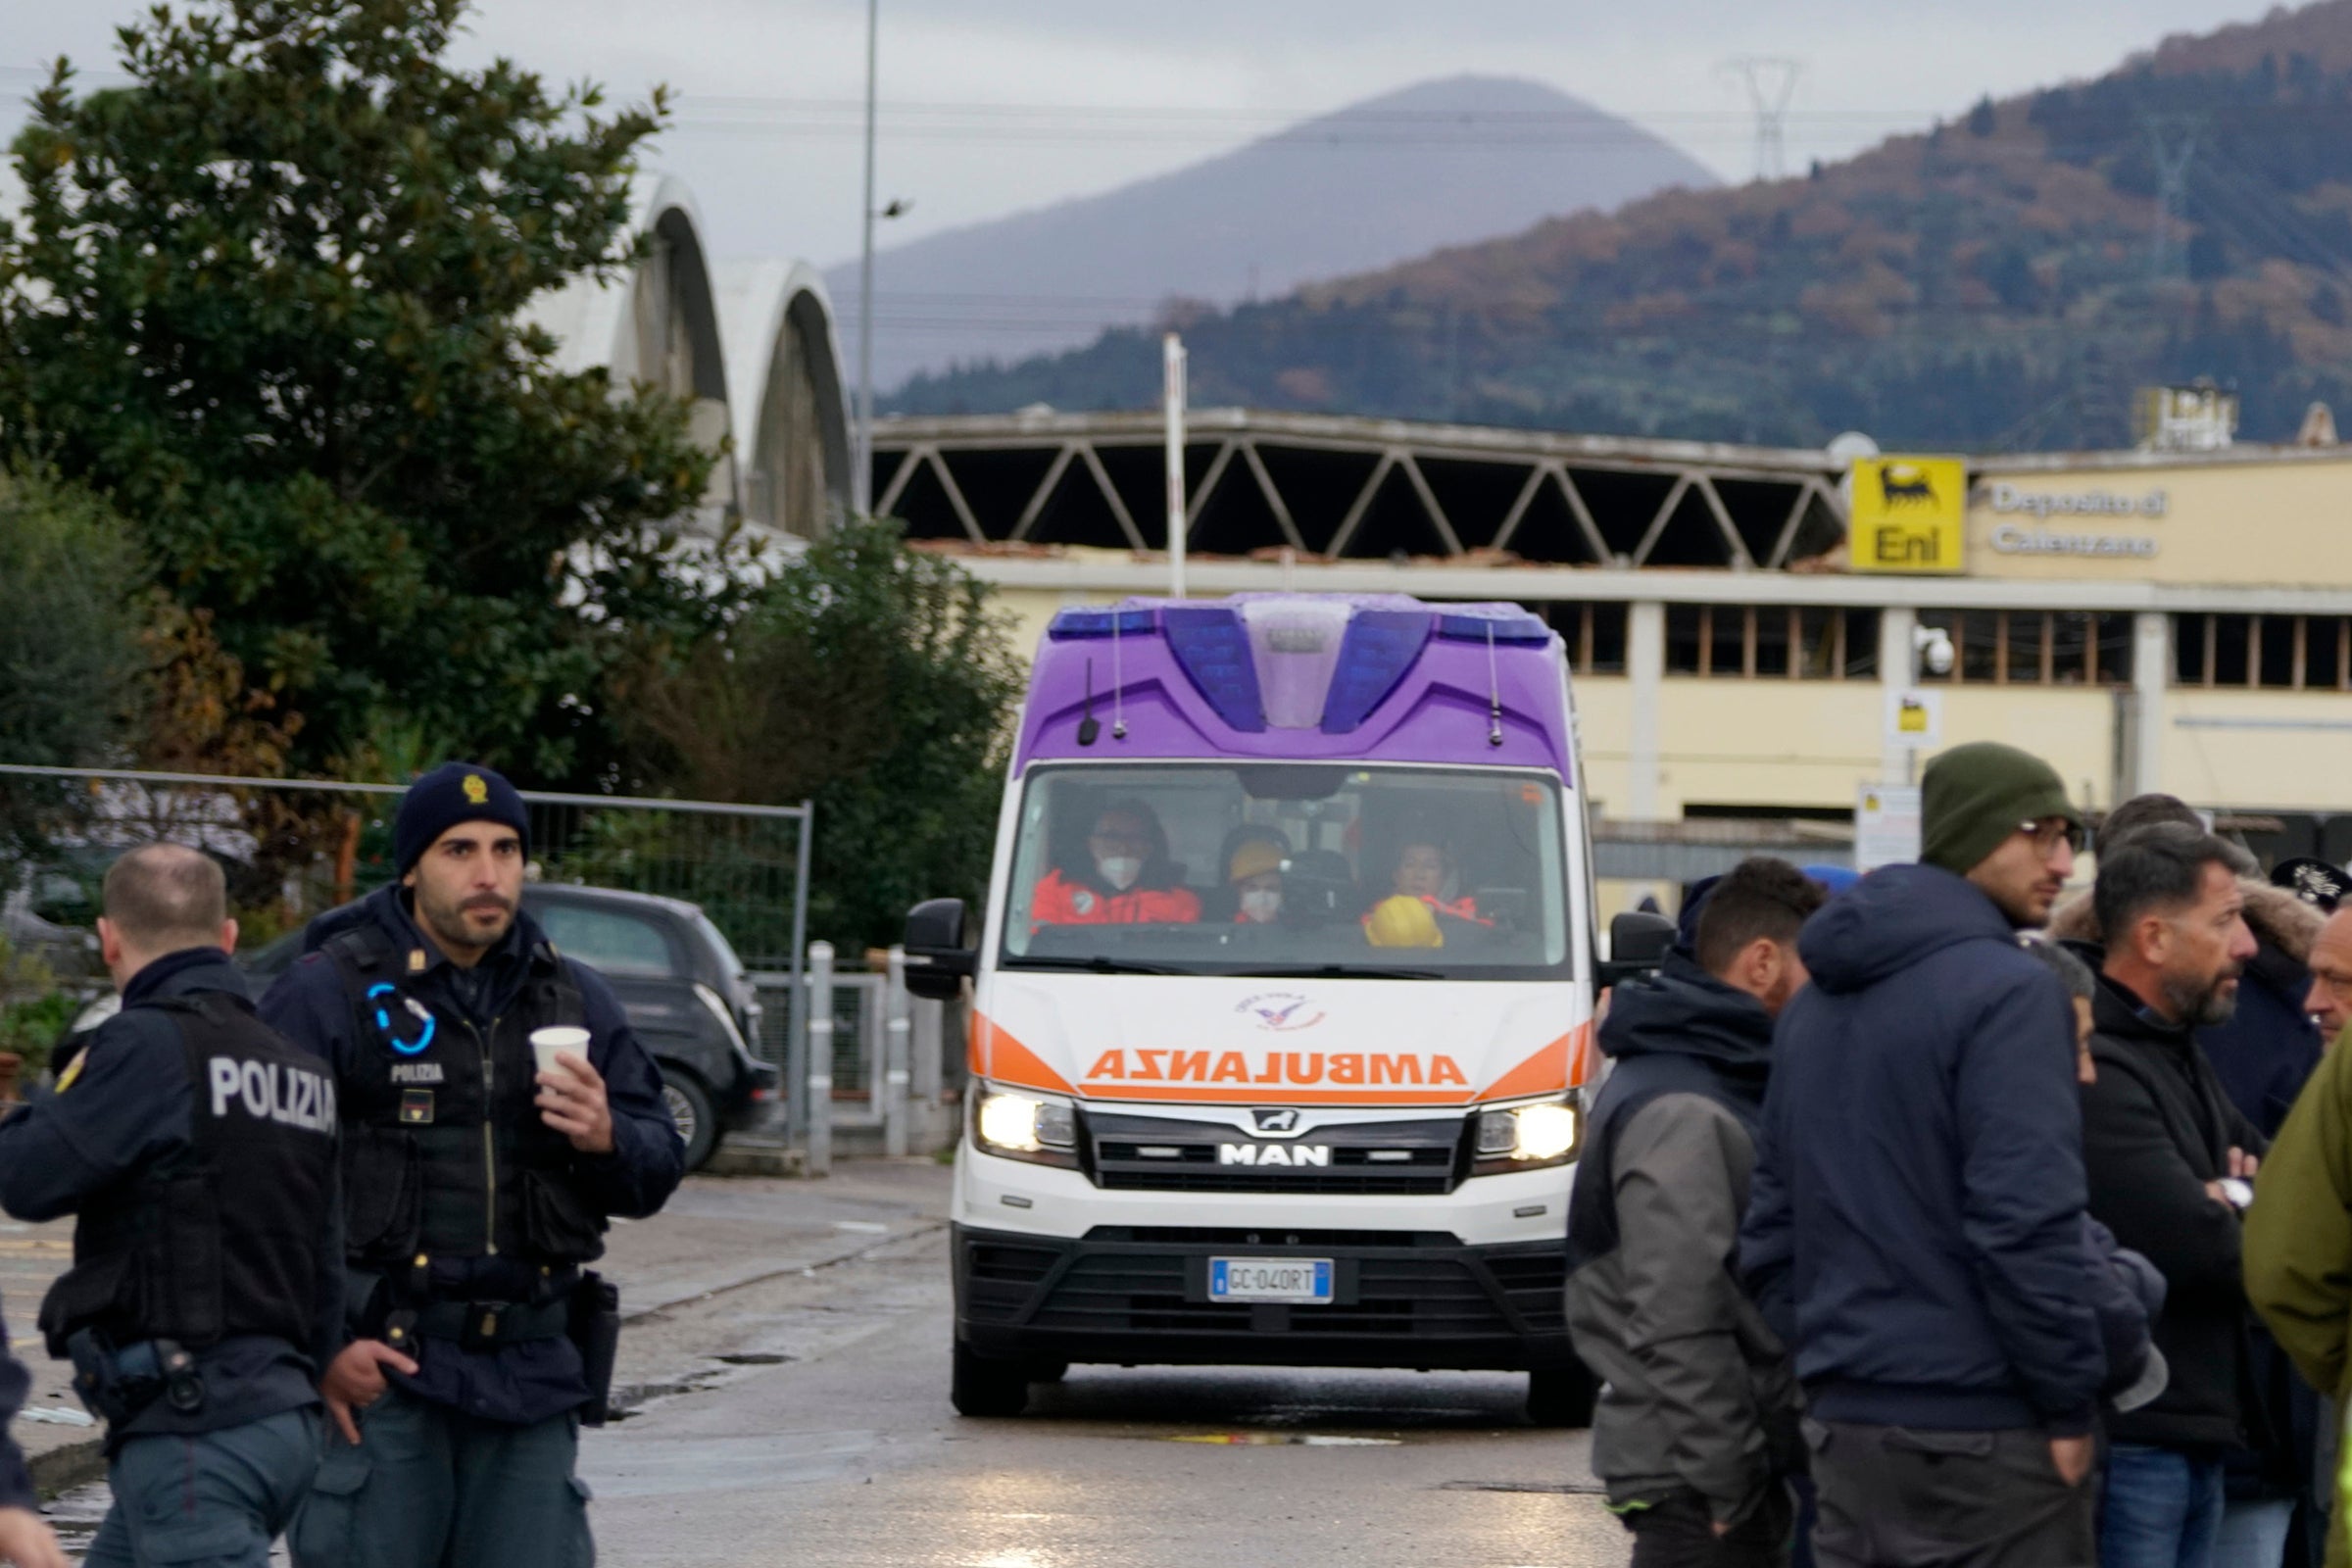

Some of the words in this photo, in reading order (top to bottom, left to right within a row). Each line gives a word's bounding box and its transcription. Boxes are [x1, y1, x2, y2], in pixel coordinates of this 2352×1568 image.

[1993, 483, 2135, 518] Deposito
[1877, 527, 1939, 563] Eni
[391, 1063, 445, 1083] POLIZIA
[1219, 1144, 1330, 1167] MAN
